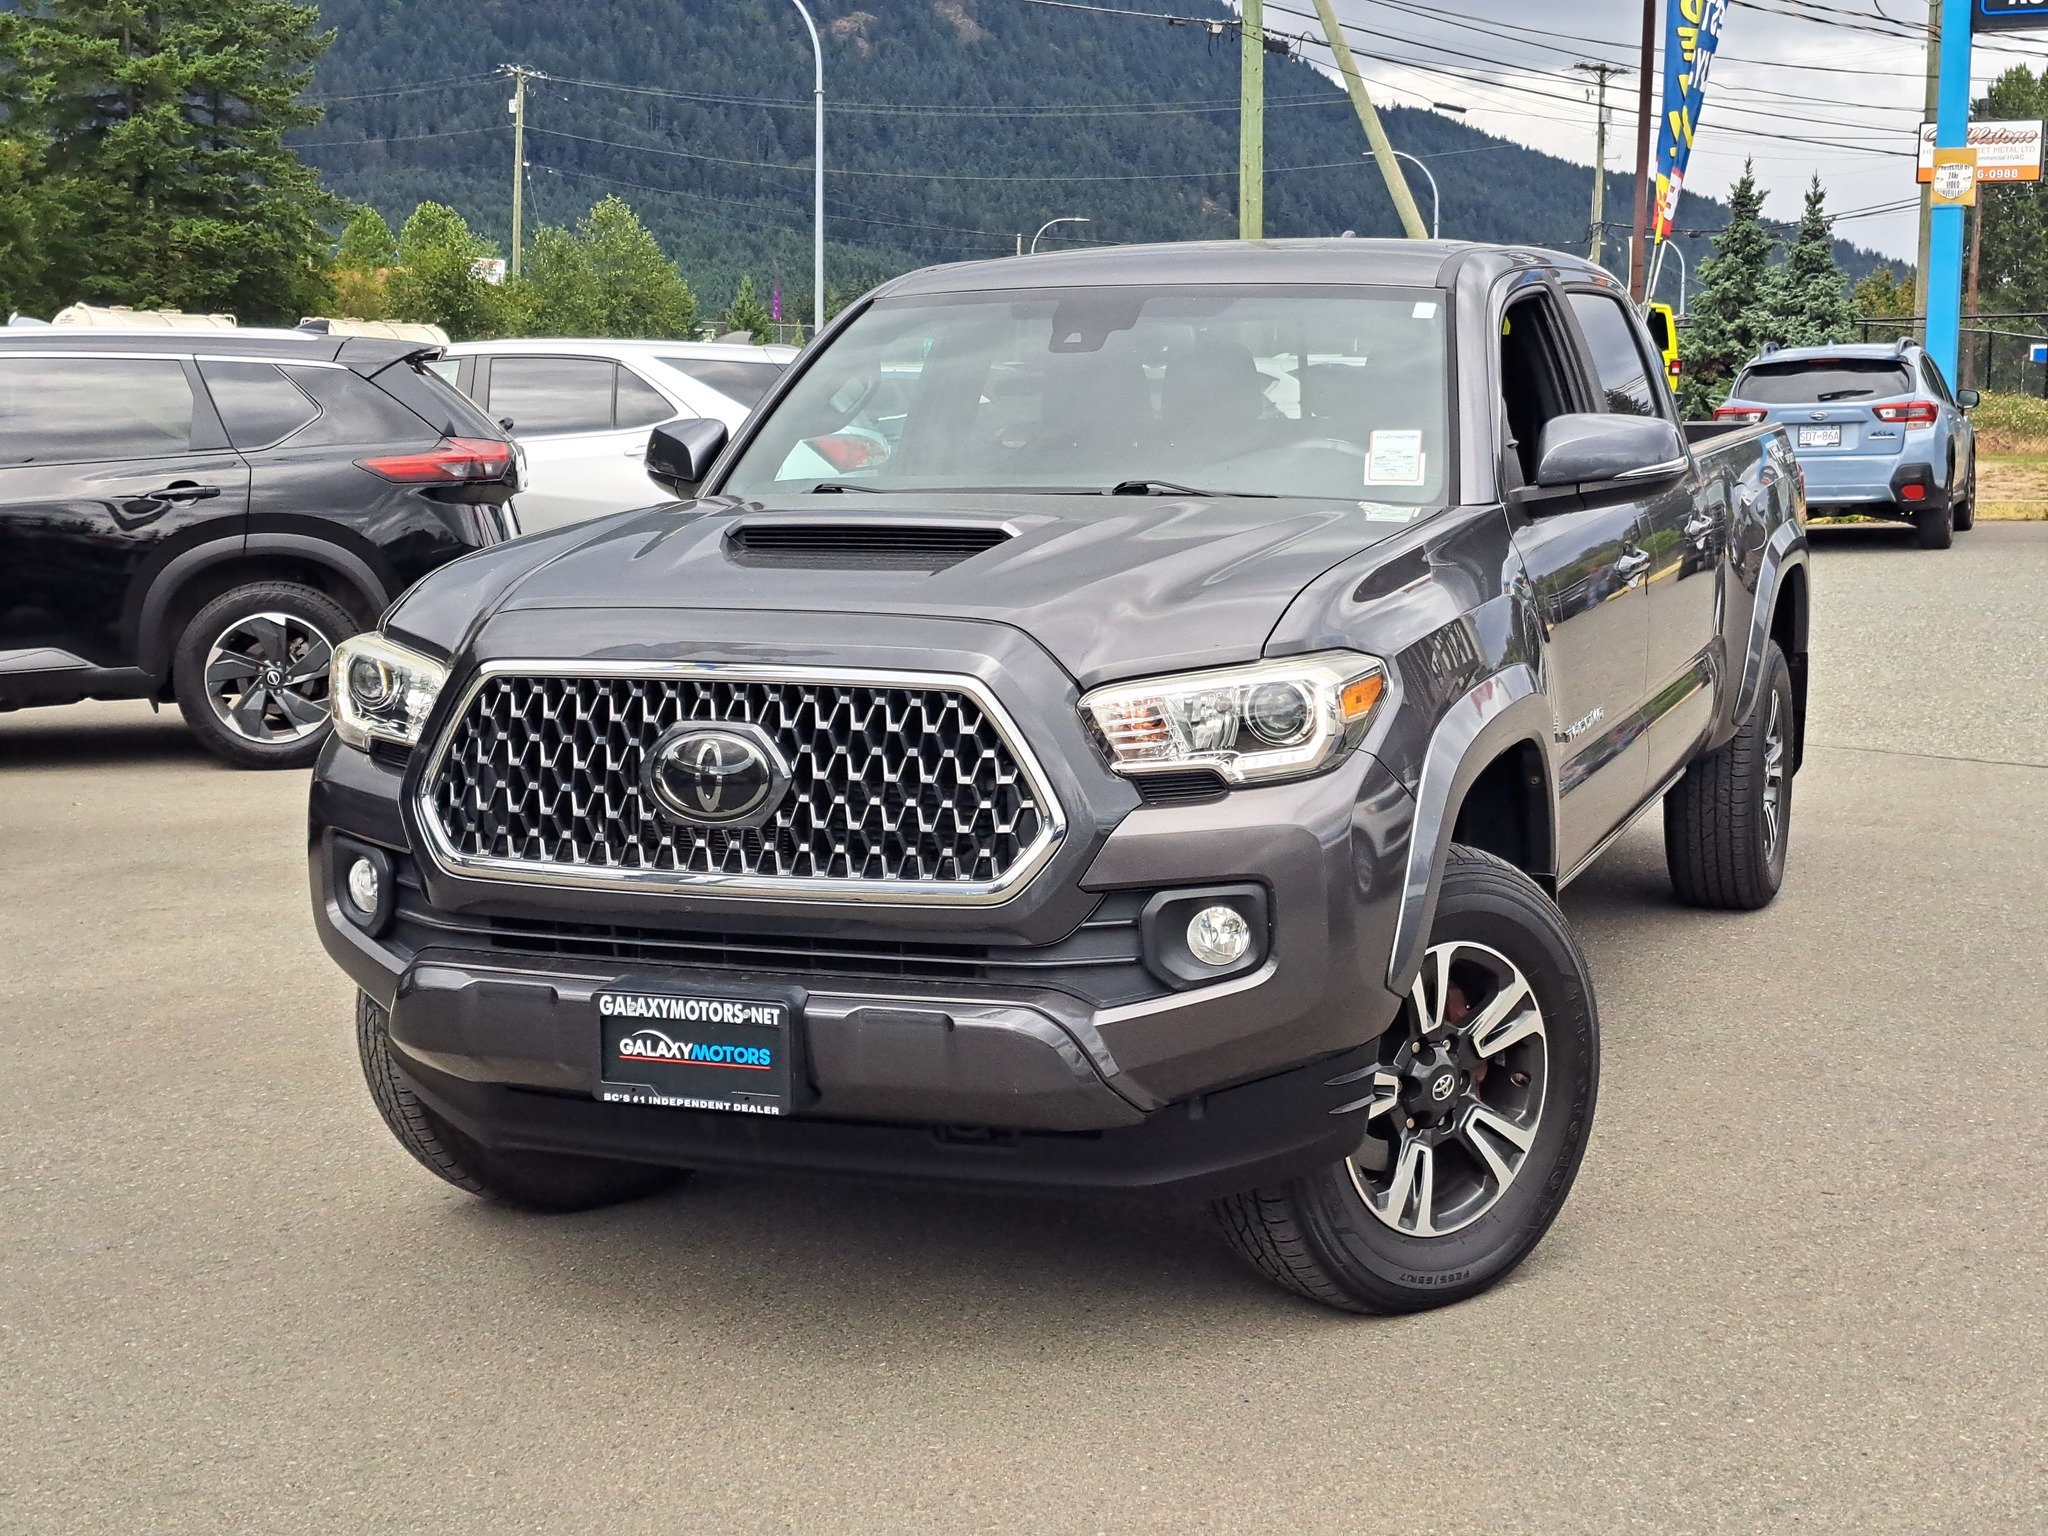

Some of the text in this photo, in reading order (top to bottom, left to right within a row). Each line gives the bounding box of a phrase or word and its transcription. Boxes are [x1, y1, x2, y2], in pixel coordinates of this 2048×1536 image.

[1976, 168, 2019, 179] 6-0988
[603, 1092, 630, 1103] BC'S
[648, 1095, 731, 1111] INDEPENDENT
[733, 1100, 780, 1115] DEALER
